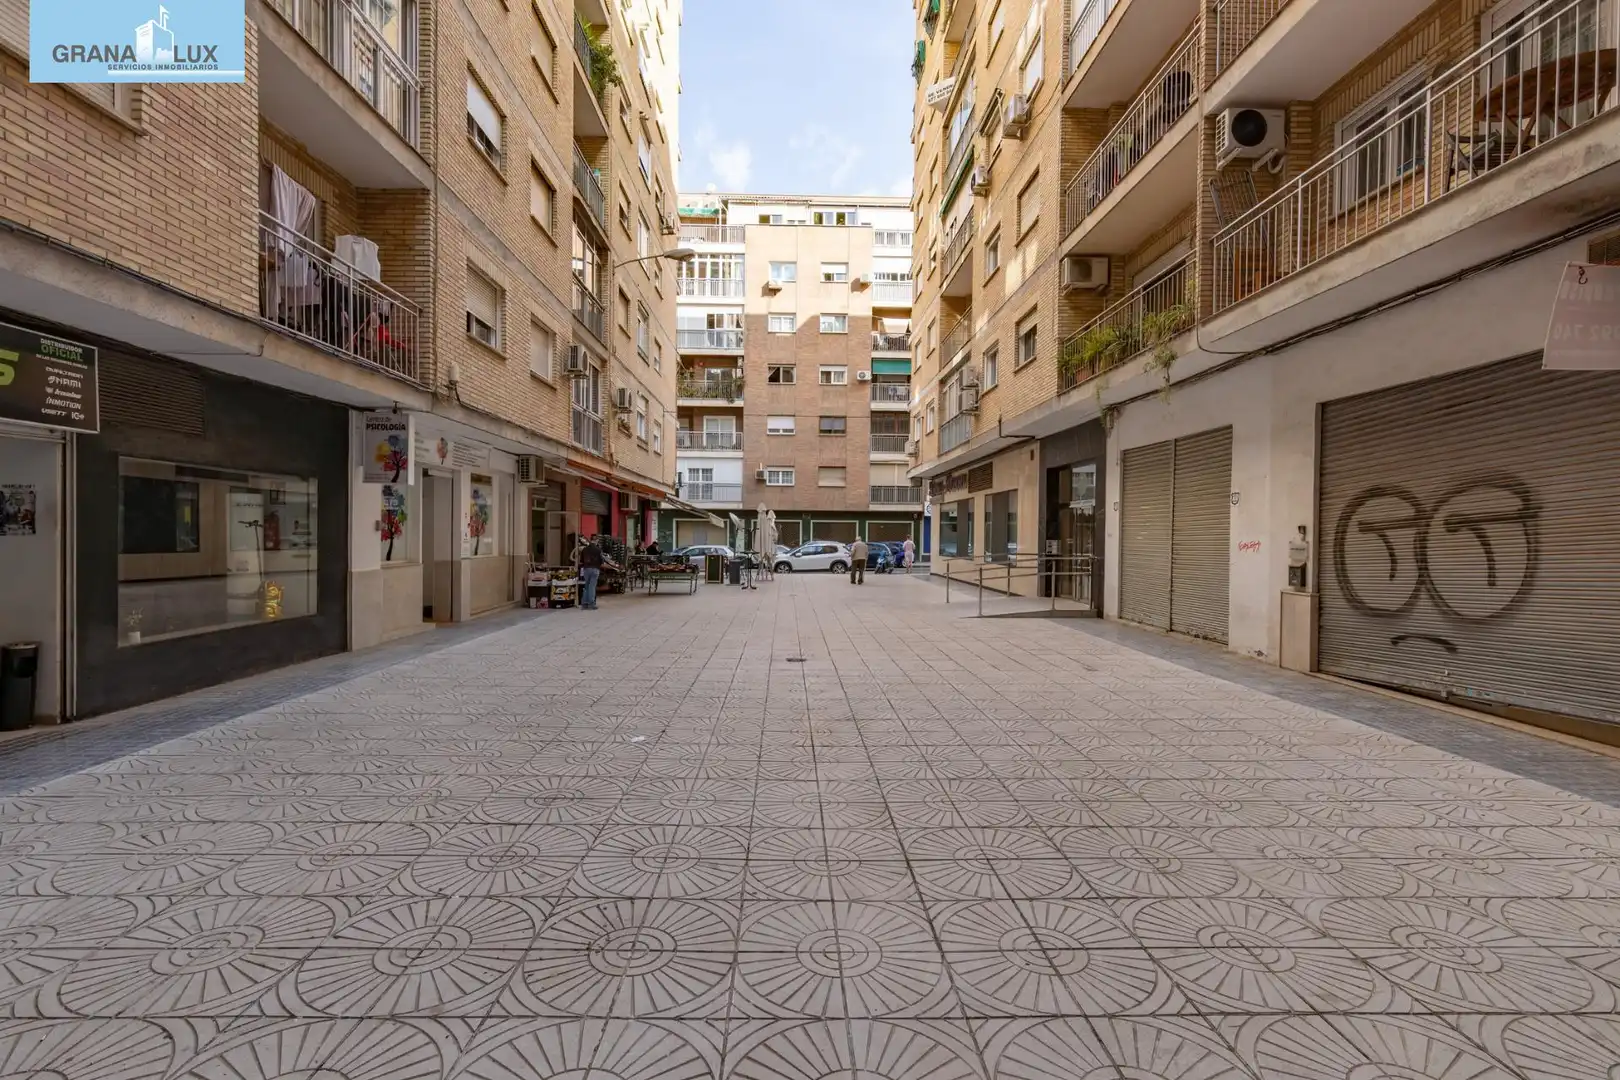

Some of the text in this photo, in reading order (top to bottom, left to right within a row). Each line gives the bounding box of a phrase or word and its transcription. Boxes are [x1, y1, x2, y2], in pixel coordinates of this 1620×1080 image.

[40, 338, 83, 353] DISTRIBUIDOR
[41, 345, 84, 362] OFICIAL
[46, 396, 82, 410] INMOTION
[366, 422, 406, 432] PSICOLOGÍA
